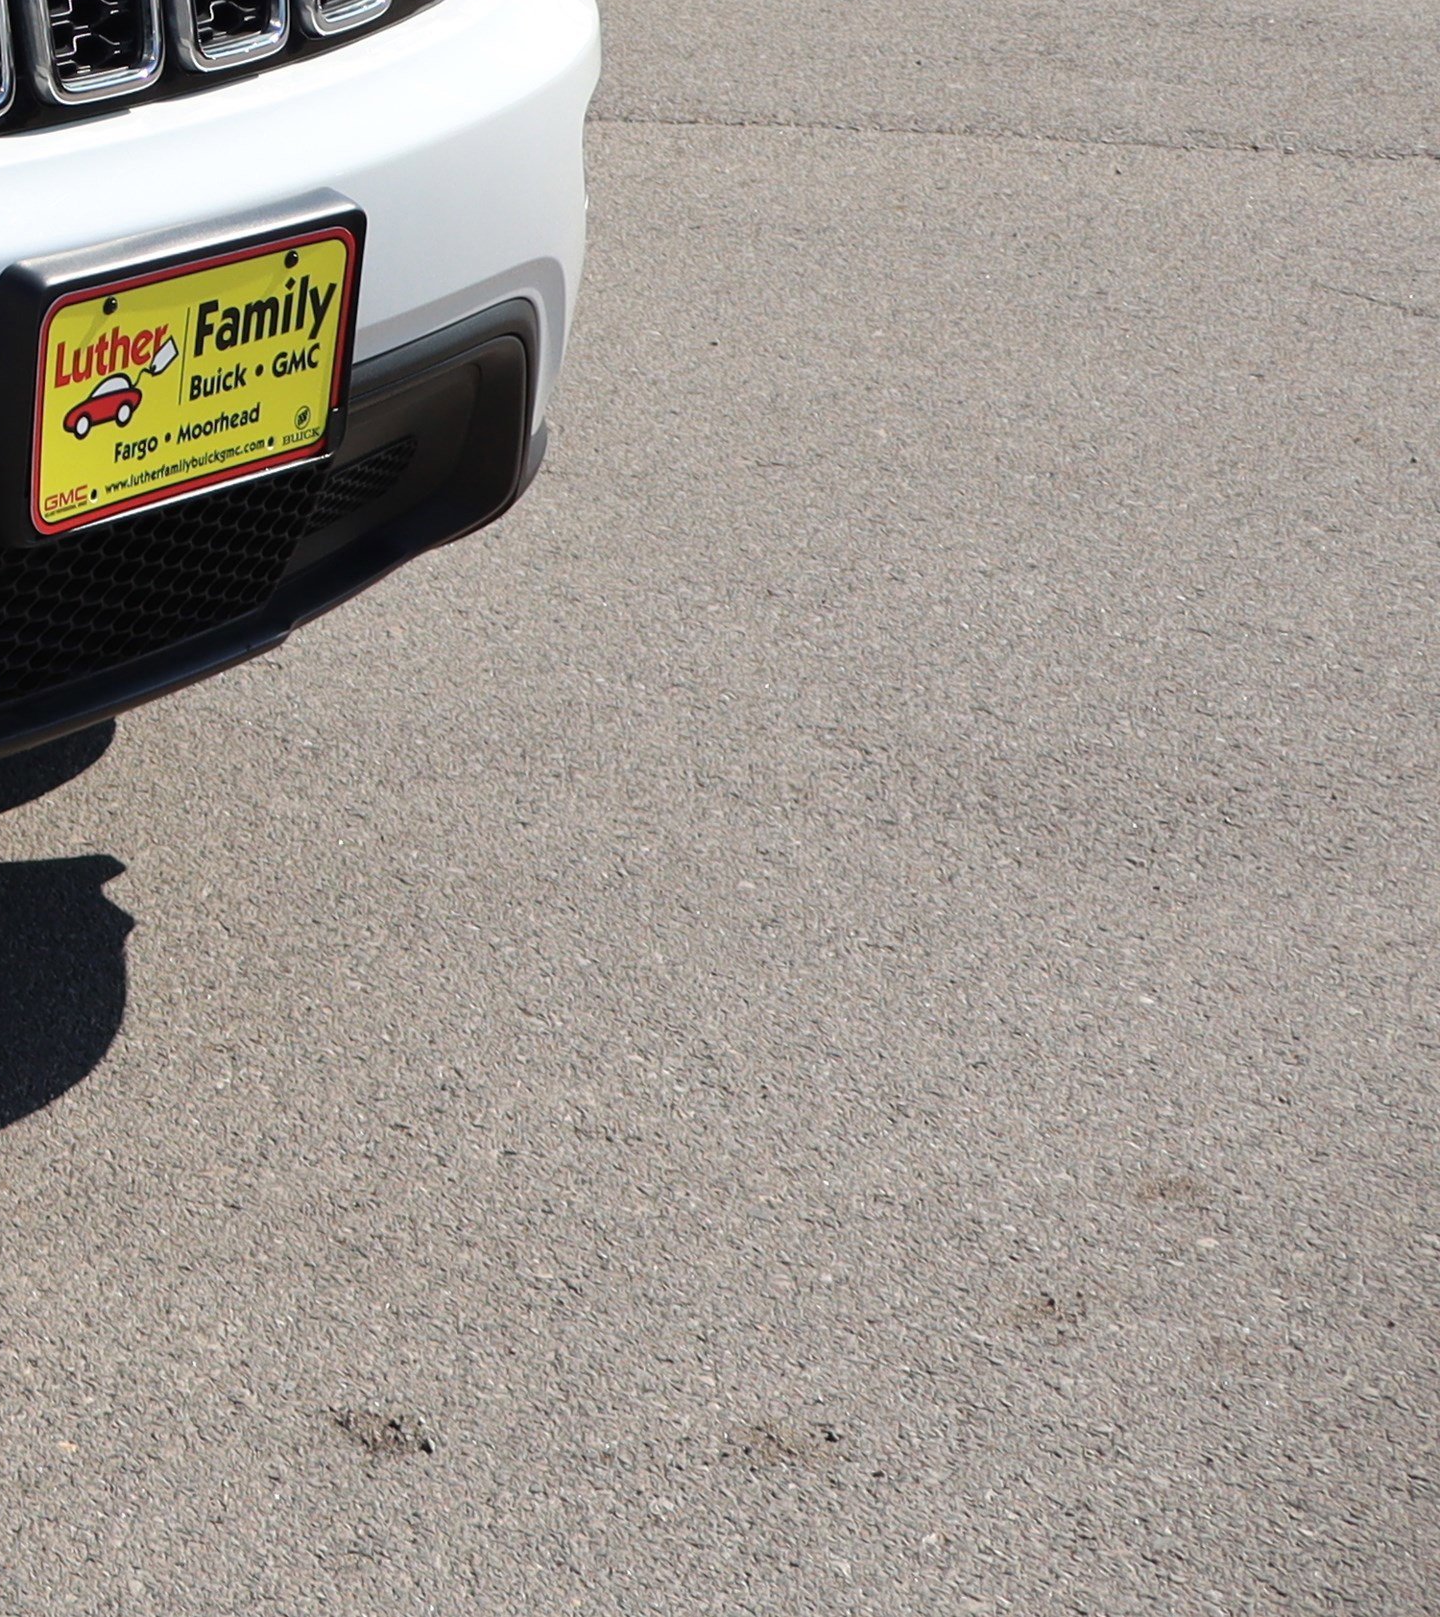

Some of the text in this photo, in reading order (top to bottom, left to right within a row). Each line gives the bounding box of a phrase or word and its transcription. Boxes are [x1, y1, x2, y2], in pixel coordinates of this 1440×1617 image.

[193, 275, 338, 358] Family
[54, 323, 169, 388] Luther
[189, 343, 320, 402] Buick GMC
[114, 402, 261, 463] Fargo Moorhead
[282, 427, 320, 447] BUICK
[105, 438, 265, 494] www.lutherfamilybuickgmc.com
[44, 484, 88, 511] GMC
